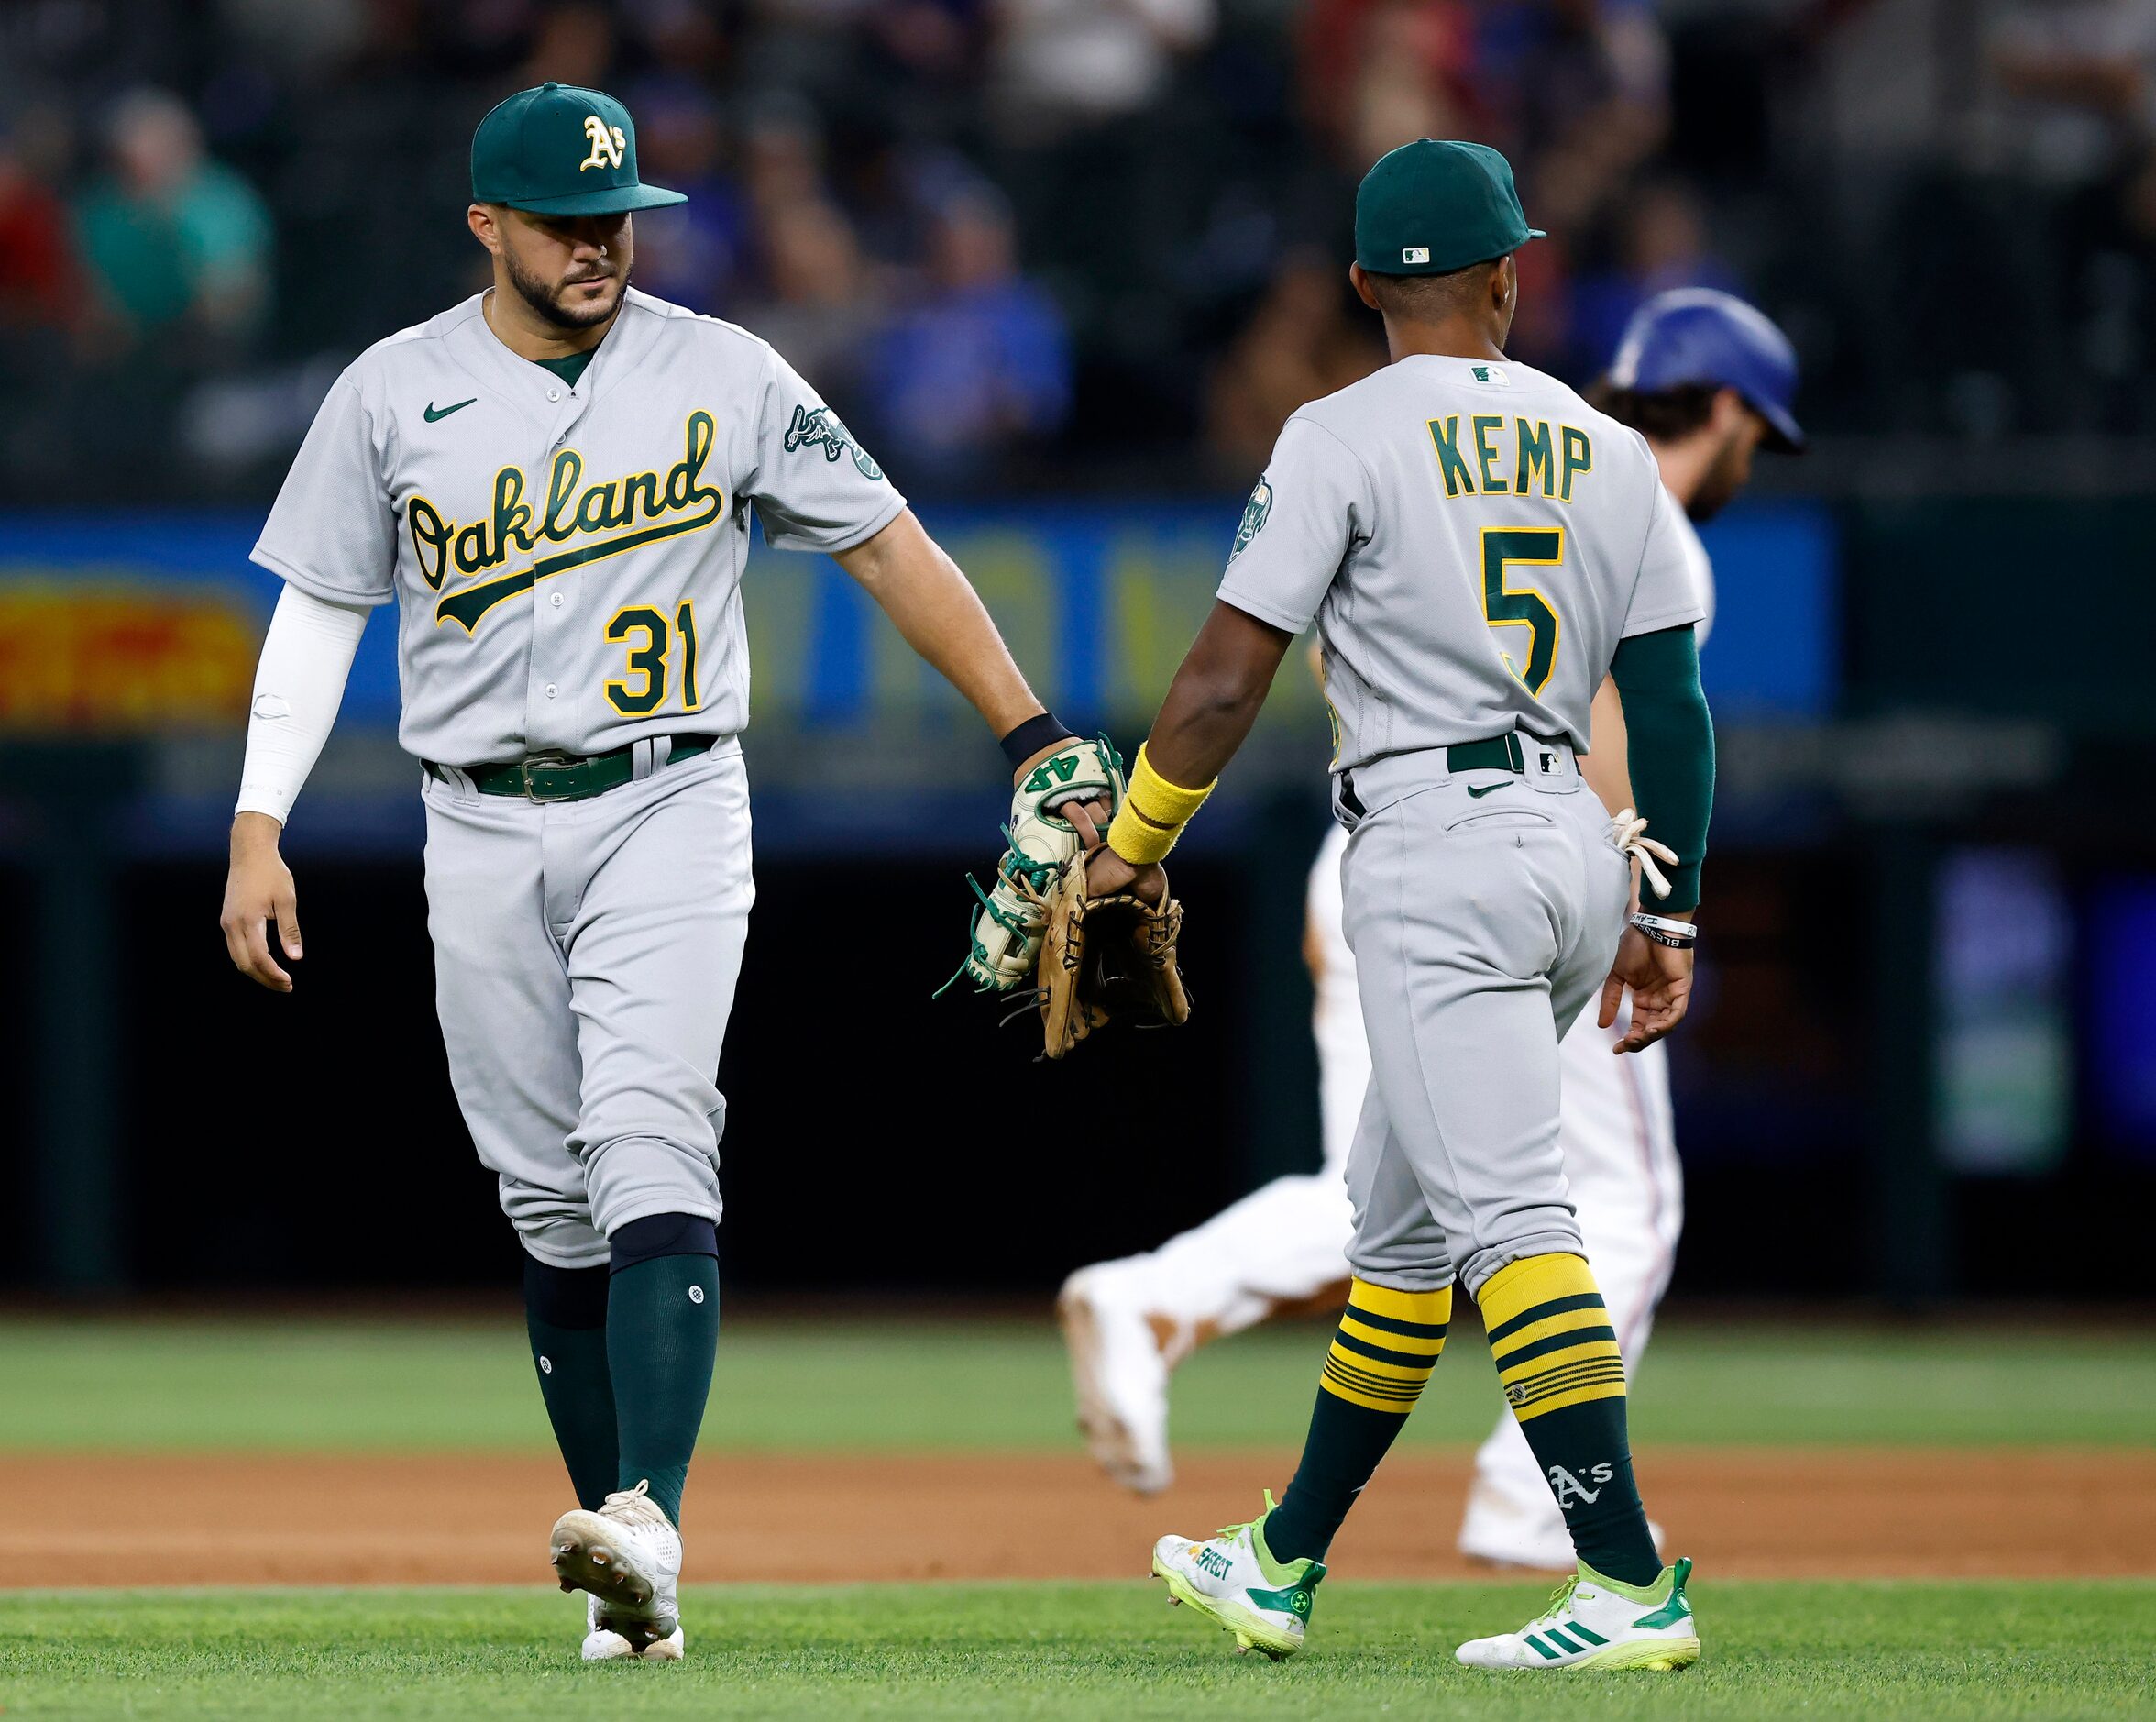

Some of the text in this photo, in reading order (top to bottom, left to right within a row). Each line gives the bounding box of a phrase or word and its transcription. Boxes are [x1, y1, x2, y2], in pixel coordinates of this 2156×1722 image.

[579, 115, 626, 171] A's
[408, 408, 721, 592] Oakland
[1425, 413, 1593, 503] KEMP
[602, 598, 699, 717] 31
[1479, 525, 1565, 701] 5
[1025, 755, 1080, 794] 44
[1547, 1462, 1613, 1509] A's
